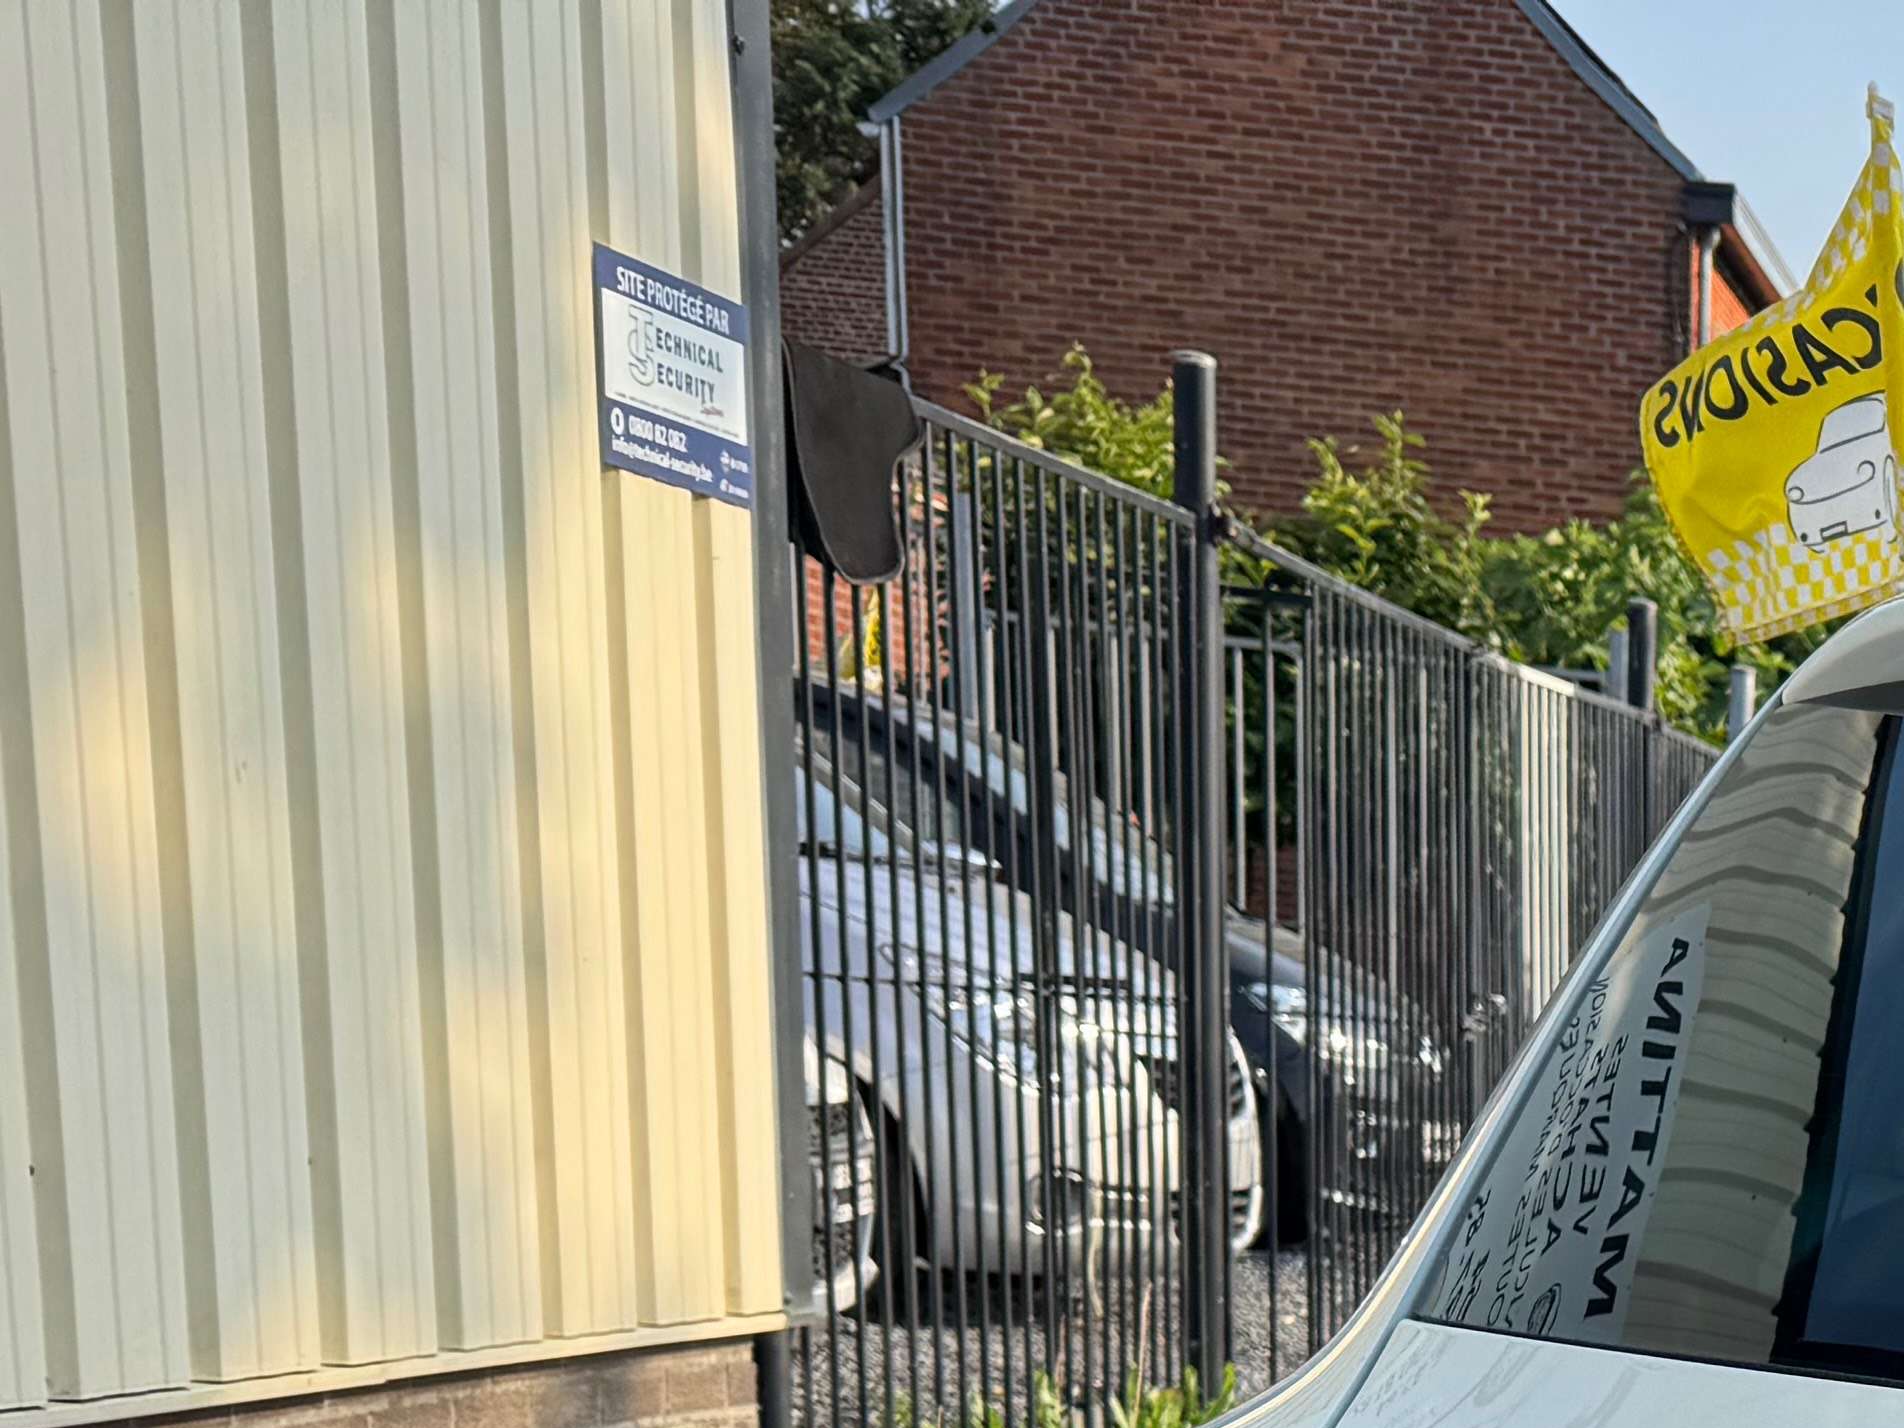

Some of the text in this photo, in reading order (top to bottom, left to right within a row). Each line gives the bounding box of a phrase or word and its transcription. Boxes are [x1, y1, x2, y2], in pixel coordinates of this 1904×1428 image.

[616, 266, 730, 335] SITE PROTÉGÉ PAR
[628, 330, 716, 404] SECURITY
[629, 304, 724, 374] TECHNICAL
